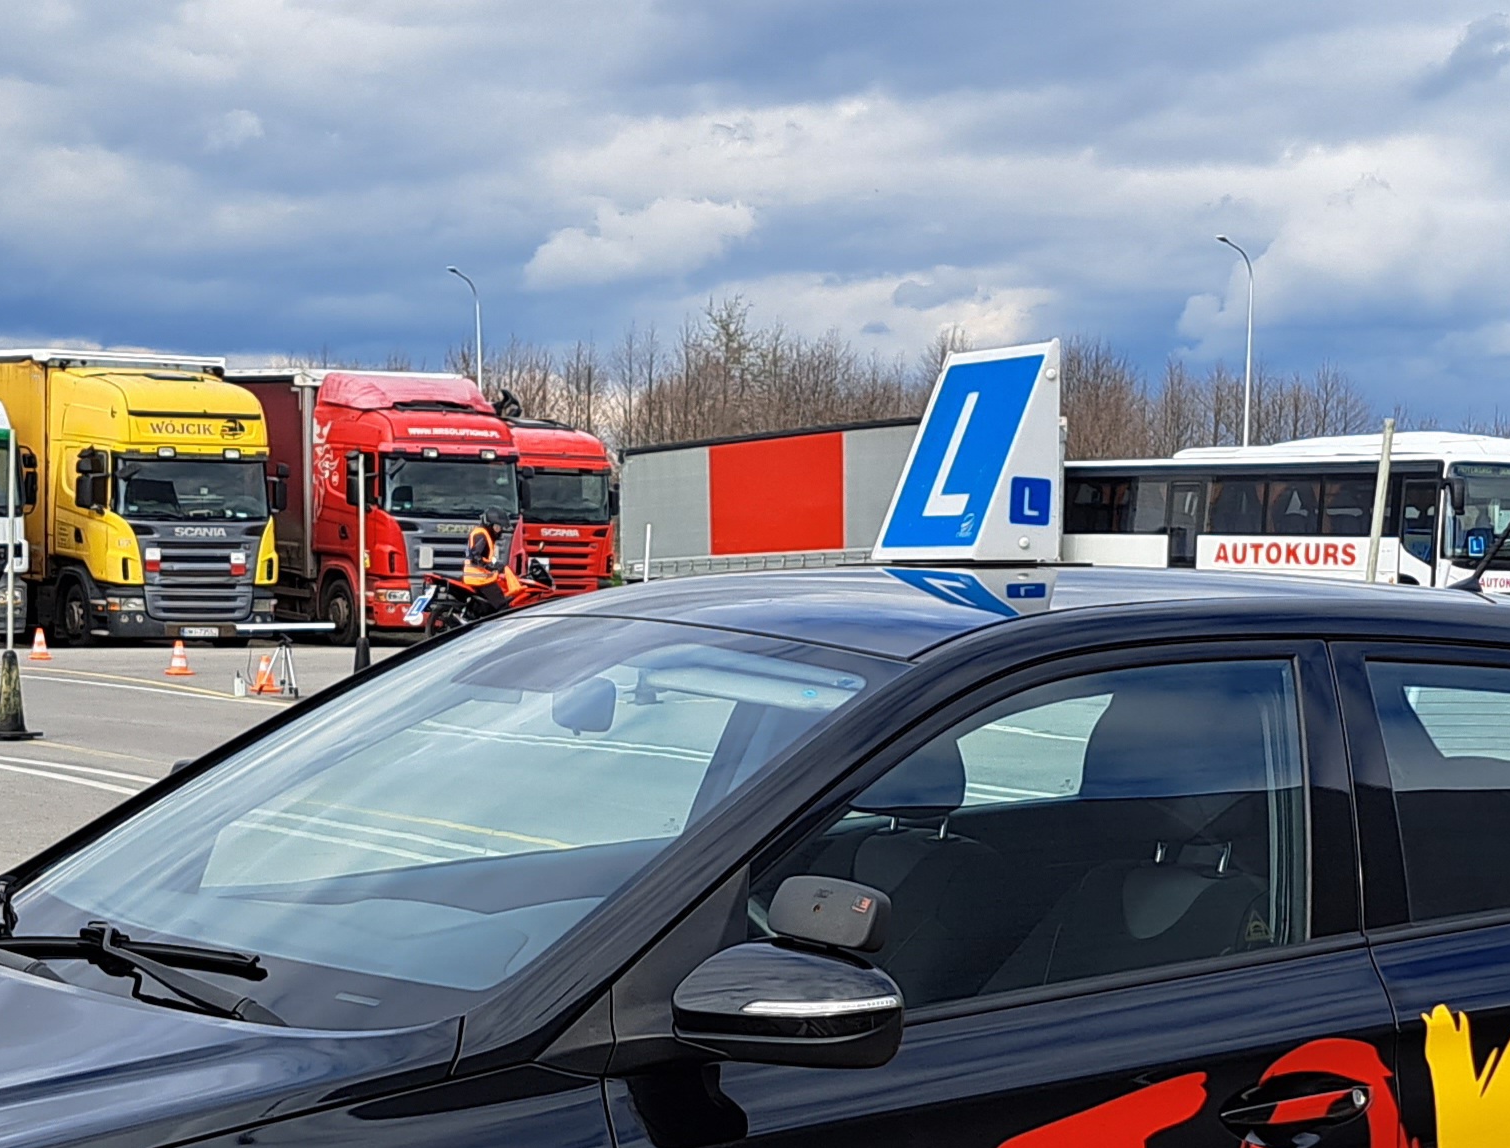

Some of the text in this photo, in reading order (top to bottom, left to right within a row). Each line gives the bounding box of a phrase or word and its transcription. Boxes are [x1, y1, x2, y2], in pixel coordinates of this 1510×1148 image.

[149, 420, 215, 436] WÓJCIK
[922, 391, 980, 517] L
[1023, 486, 1040, 516] L
[174, 526, 227, 537] SCANIA
[540, 528, 580, 538] SCANIA
[1214, 542, 1357, 567] AUTOKURS
